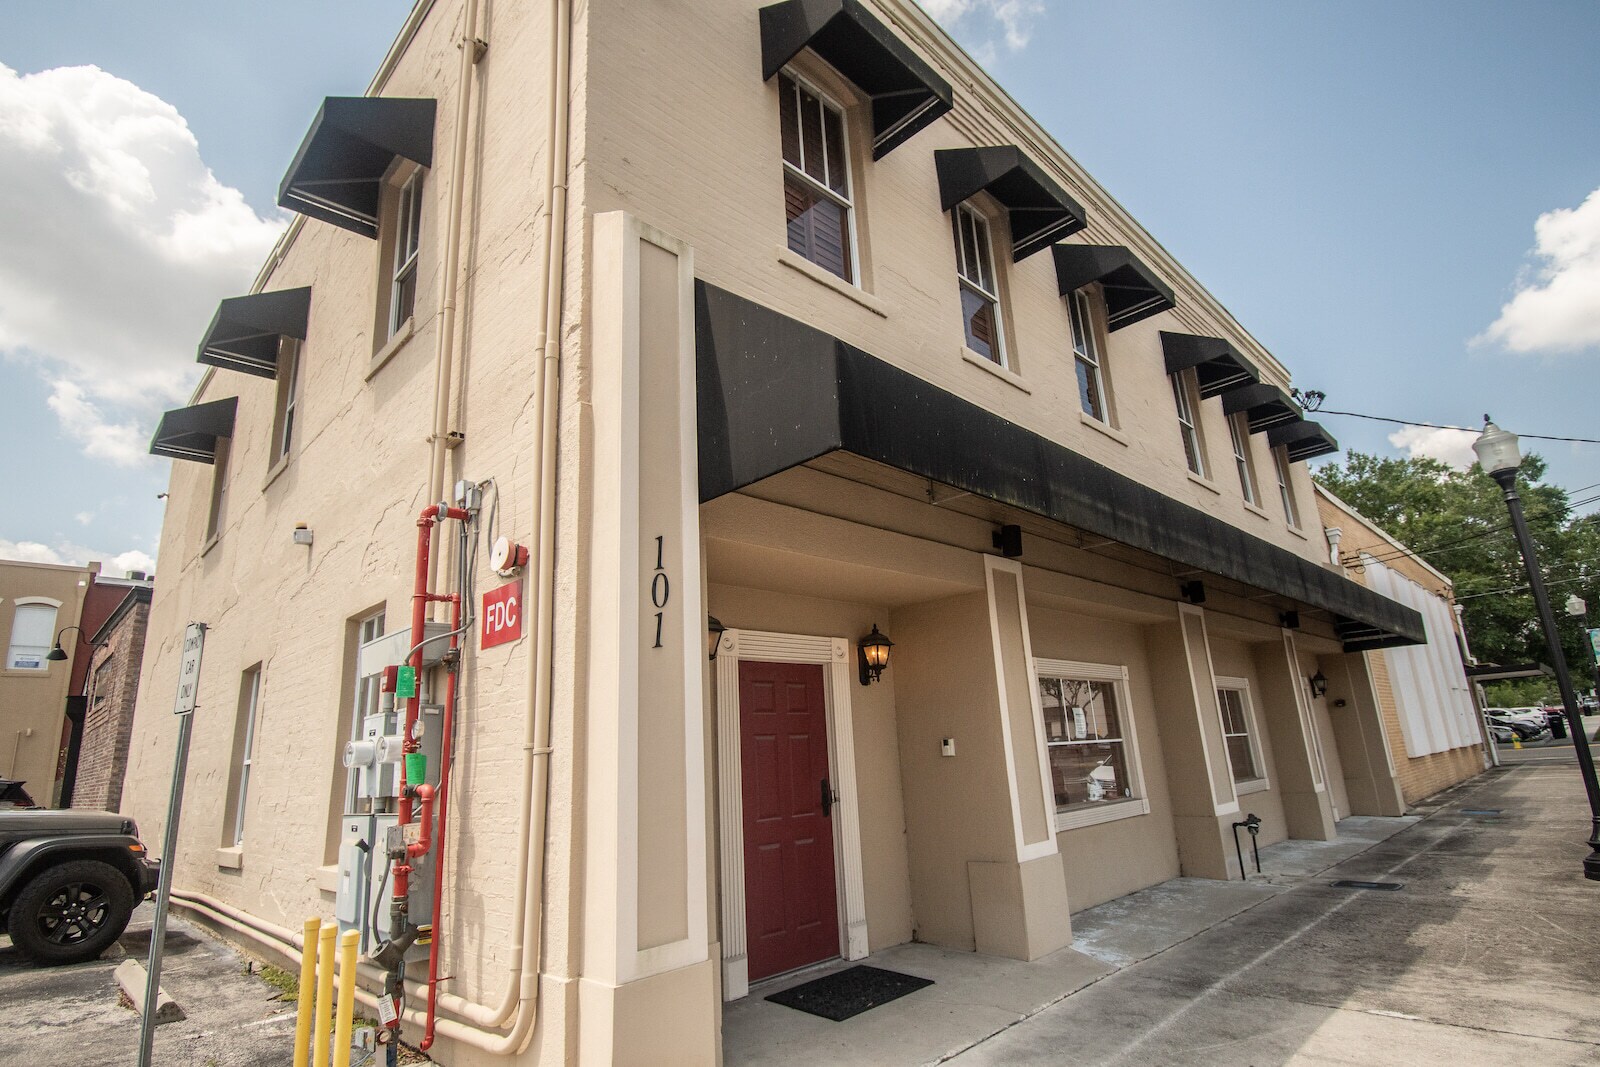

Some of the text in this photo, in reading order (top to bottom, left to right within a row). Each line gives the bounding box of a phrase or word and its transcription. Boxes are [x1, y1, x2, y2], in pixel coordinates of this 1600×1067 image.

[652, 536, 669, 648] 101
[486, 597, 517, 634] FDC
[186, 659, 195, 675] CAR
[181, 683, 193, 699] ONLY
